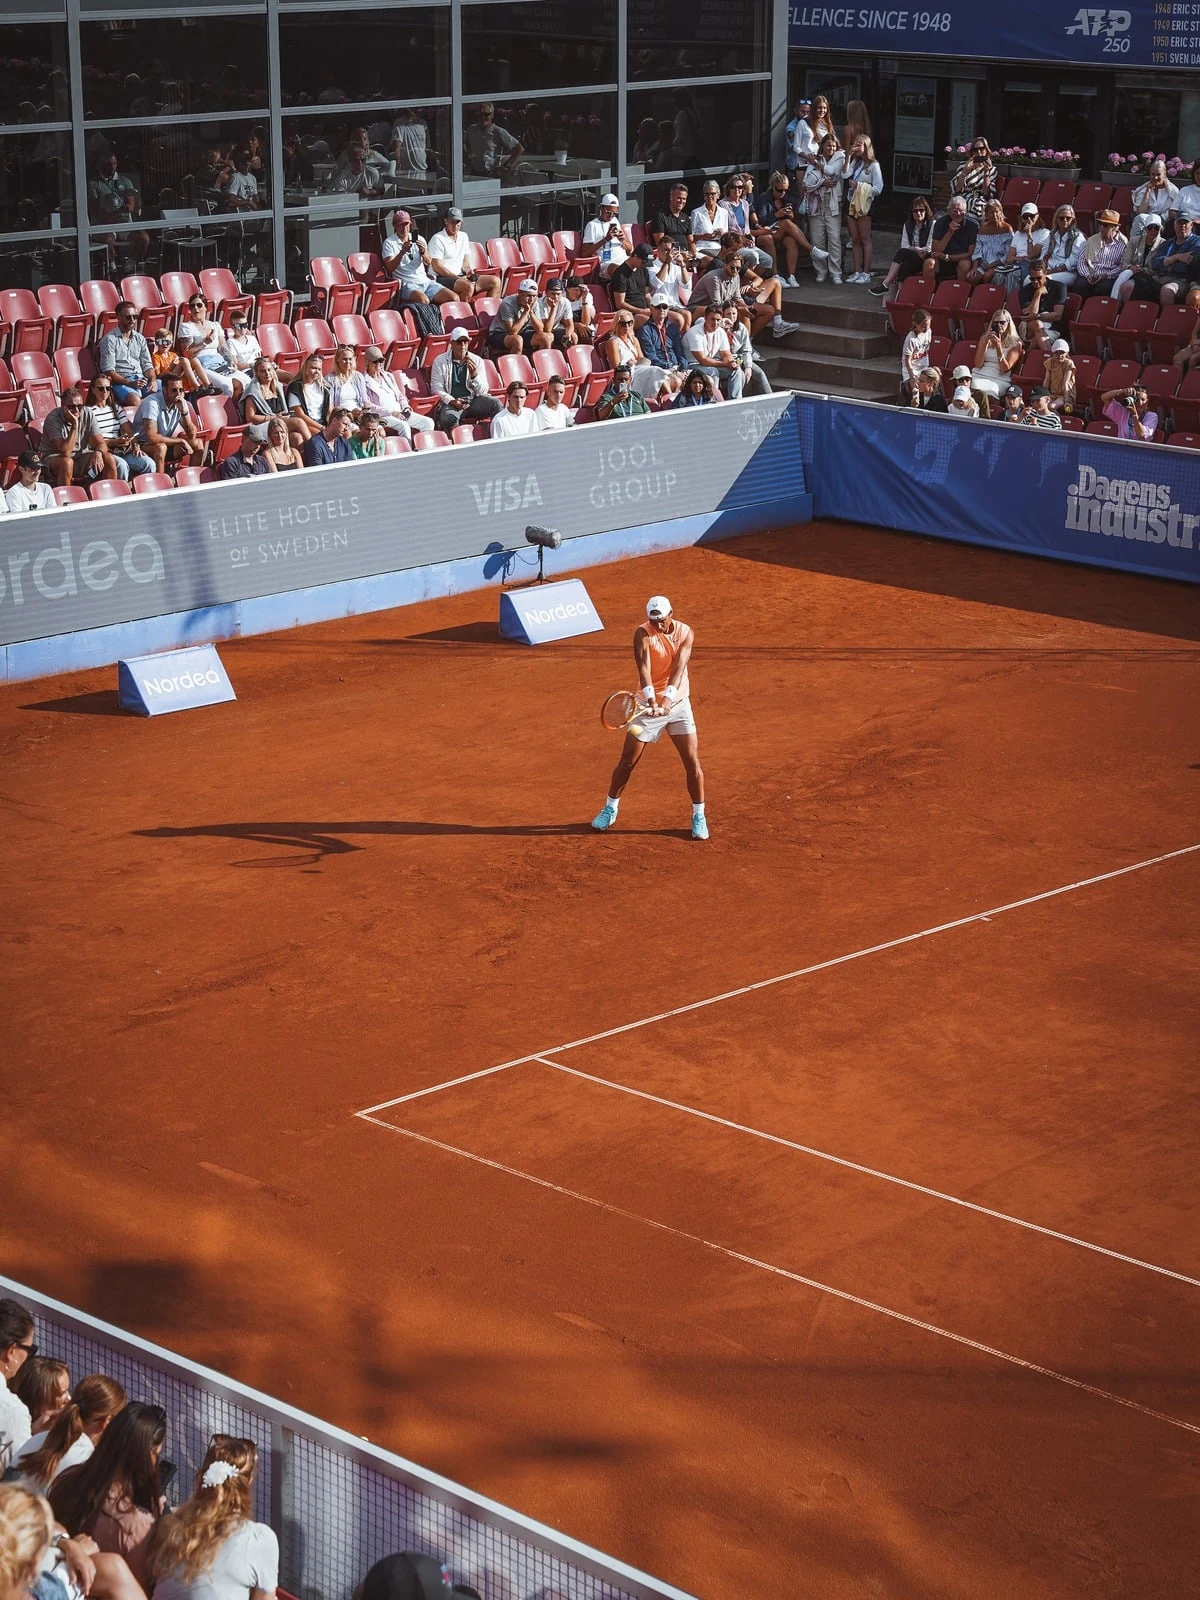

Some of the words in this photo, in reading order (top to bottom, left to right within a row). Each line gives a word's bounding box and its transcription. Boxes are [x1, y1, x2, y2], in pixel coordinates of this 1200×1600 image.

[857, 9, 909, 30] SINCE
[912, 11, 951, 32] 1948
[1064, 8, 1131, 36] ATP
[1155, 3, 1171, 14] 1948
[1173, 3, 1190, 15] ERIC
[1154, 19, 1170, 31] 1949
[1171, 20, 1189, 31] ERIC
[1102, 37, 1131, 53] 250
[1153, 35, 1169, 47] 1950
[1170, 36, 1188, 47] ERIC
[1189, 37, 1200, 48] ST
[1152, 52, 1168, 63] 1951
[1169, 53, 1189, 64] SVEN
[598, 440, 664, 477] JOOL
[464, 473, 544, 516] VISA
[589, 470, 677, 508] GROUP
[1078, 464, 1171, 510] Dagens
[208, 511, 269, 540] ELITE
[277, 496, 360, 528] HOTELS
[1065, 483, 1200, 550] industr
[230, 546, 249, 563] OF
[258, 528, 349, 563] SWEDEN
[0, 531, 166, 606] rdea
[524, 601, 590, 627] Nordea
[143, 669, 220, 696] Nordea
